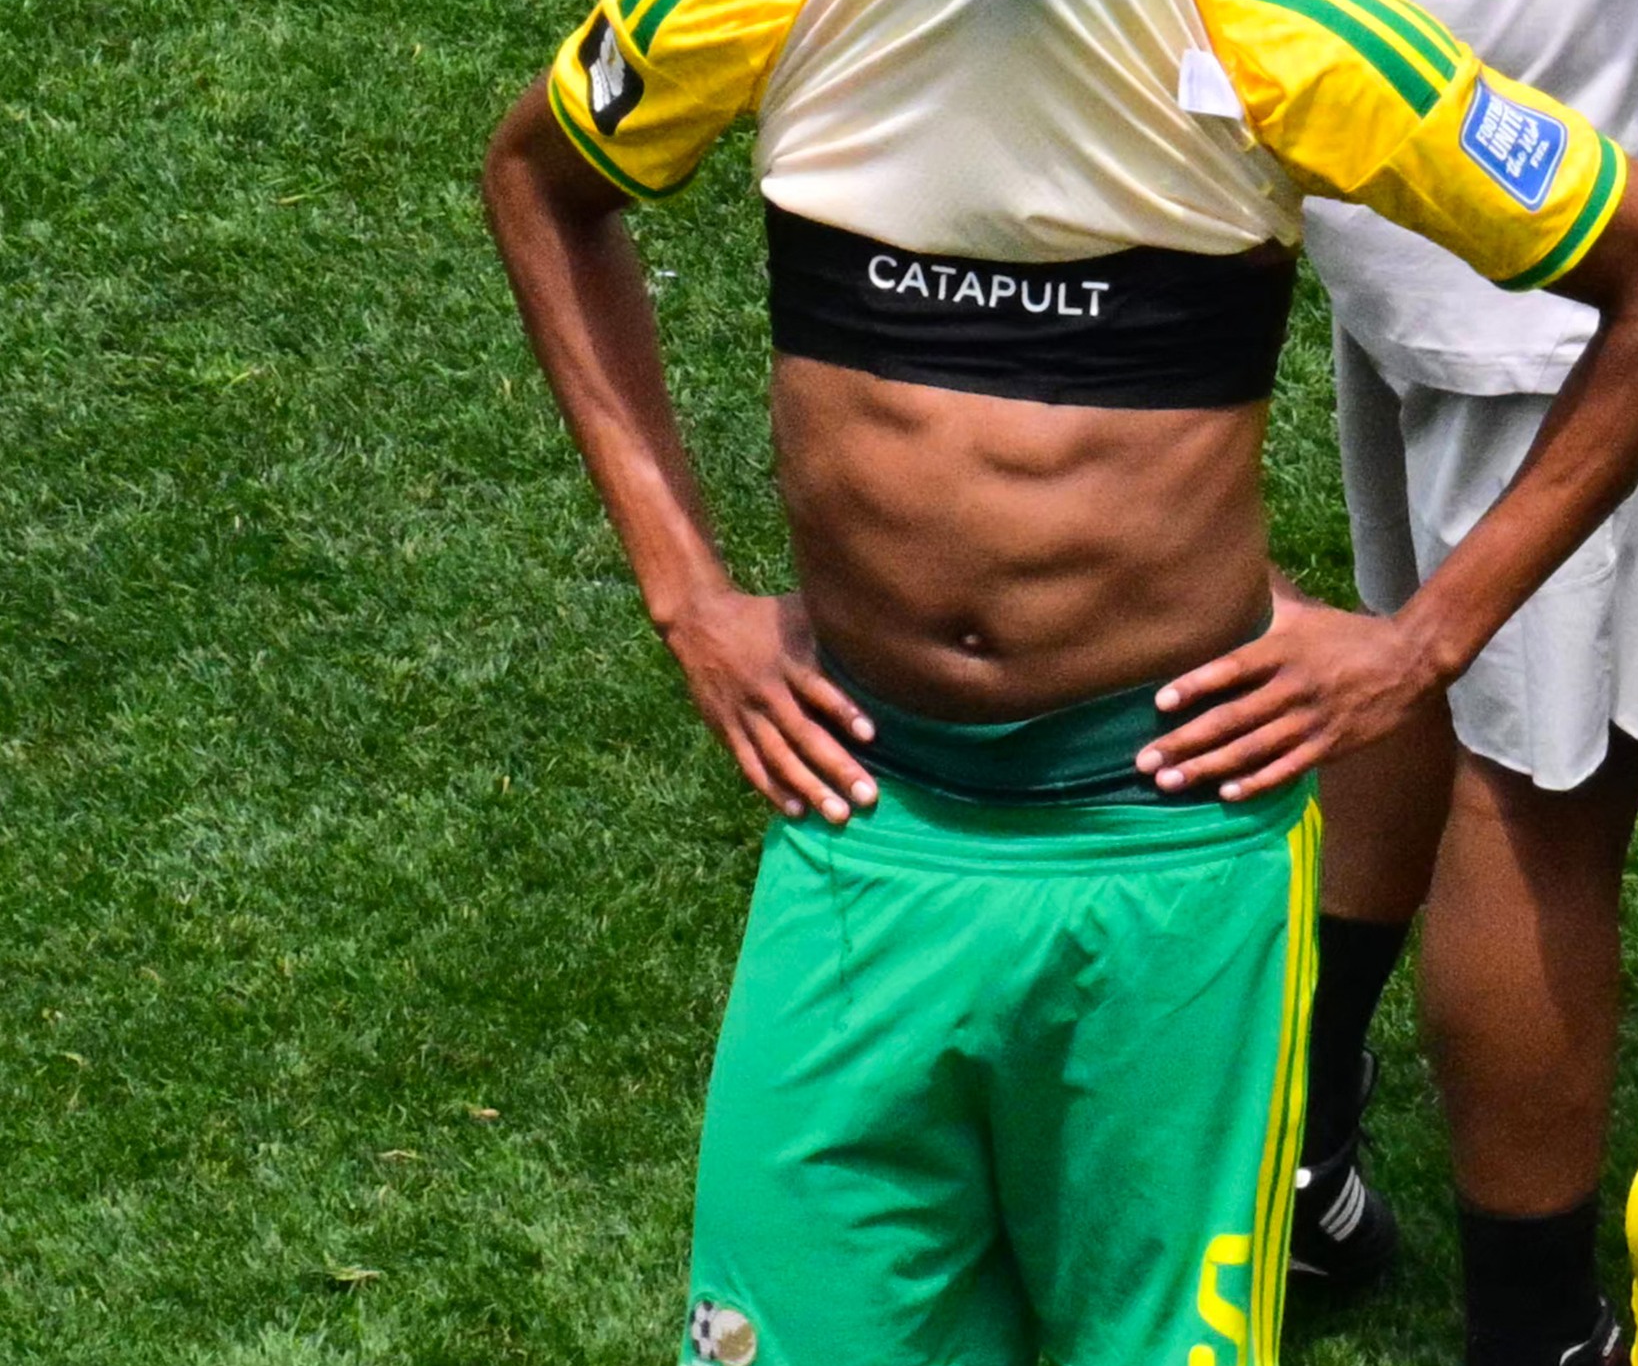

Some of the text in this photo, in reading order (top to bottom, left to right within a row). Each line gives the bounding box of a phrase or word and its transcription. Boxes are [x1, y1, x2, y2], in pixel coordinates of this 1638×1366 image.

[1475, 96, 1503, 147] FOOTB
[1488, 105, 1522, 161] UNITE
[1530, 140, 1550, 169] FIFA
[868, 255, 1110, 317] CATAPULT
